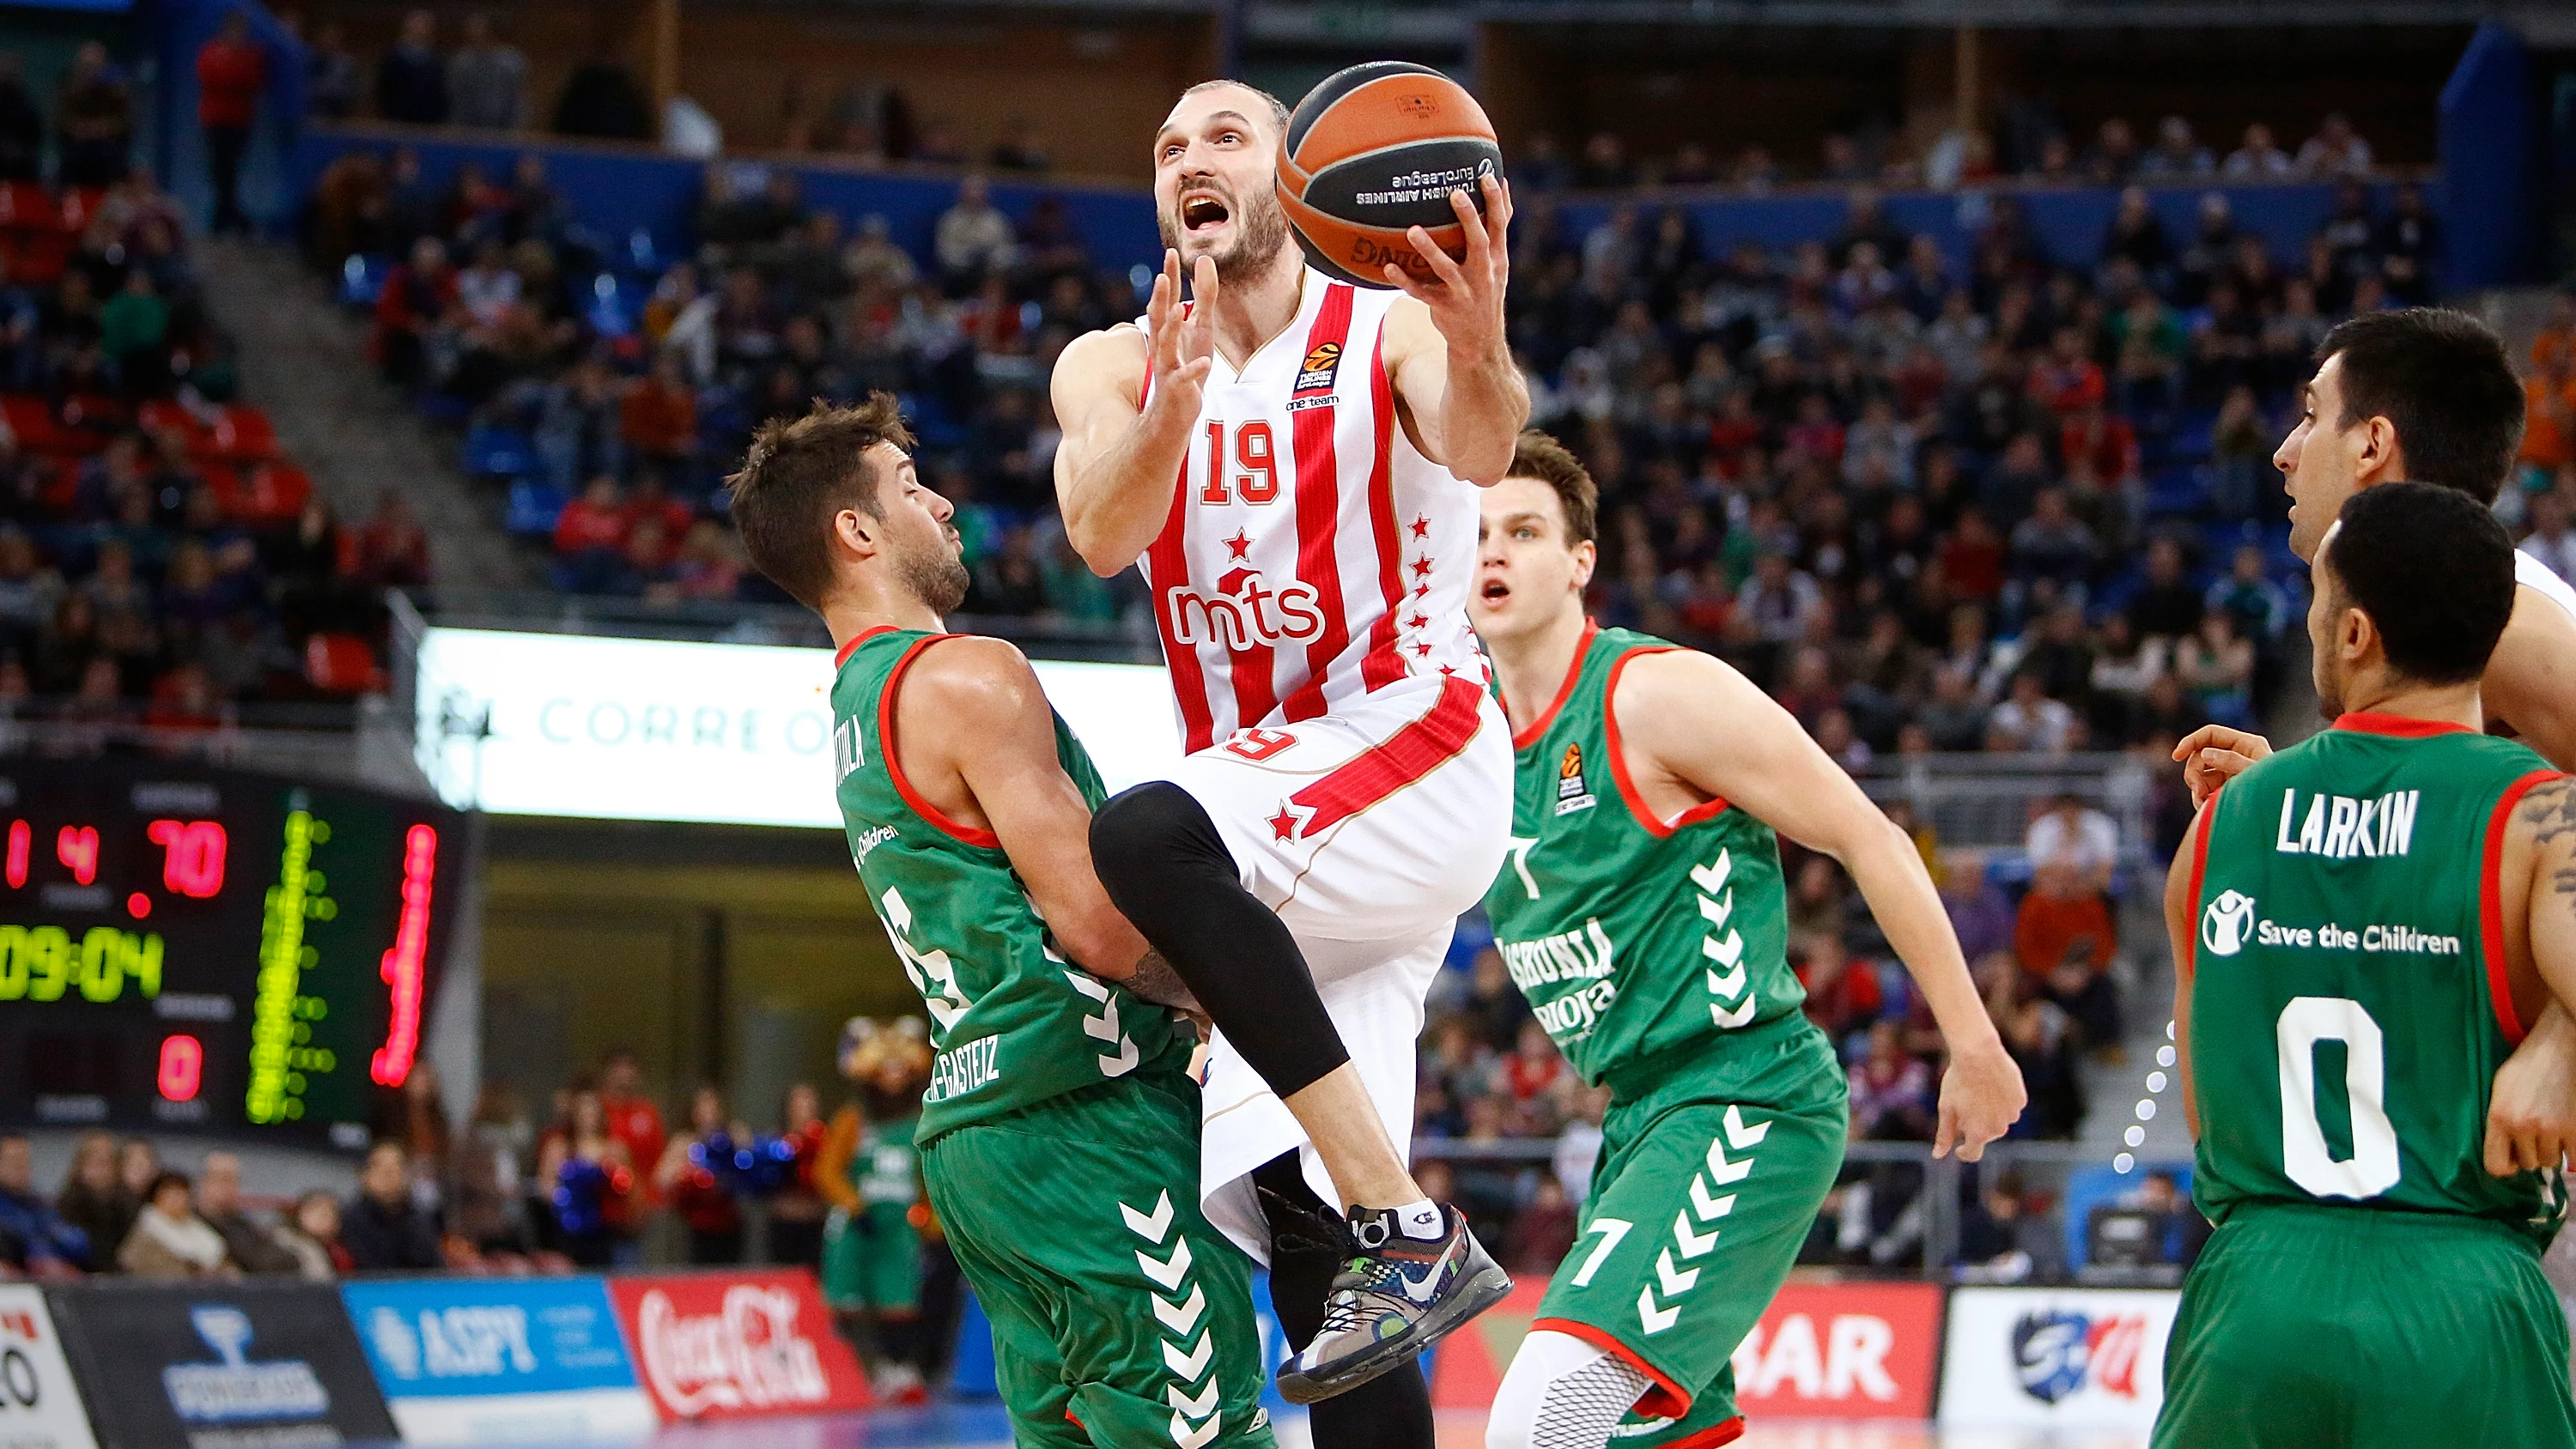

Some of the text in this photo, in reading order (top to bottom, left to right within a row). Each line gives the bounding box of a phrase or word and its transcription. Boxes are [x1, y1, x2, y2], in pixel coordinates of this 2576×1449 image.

[1356, 189, 1419, 204] AIRLINES
[1391, 167, 1474, 189] EuroLeague
[1285, 396, 1340, 411] one team
[1200, 419, 1280, 506] 19
[1173, 573, 1322, 648] mts
[538, 696, 829, 756] CORREO
[858, 823, 900, 858] Children
[2275, 788, 2421, 859] LARKIN
[147, 819, 228, 900] 70
[0, 924, 166, 1003] 09:04
[2257, 919, 2462, 955] Save the Children
[158, 1035, 204, 1102] 0
[2275, 996, 2402, 1200] 0
[1569, 1216, 1635, 1288] 7
